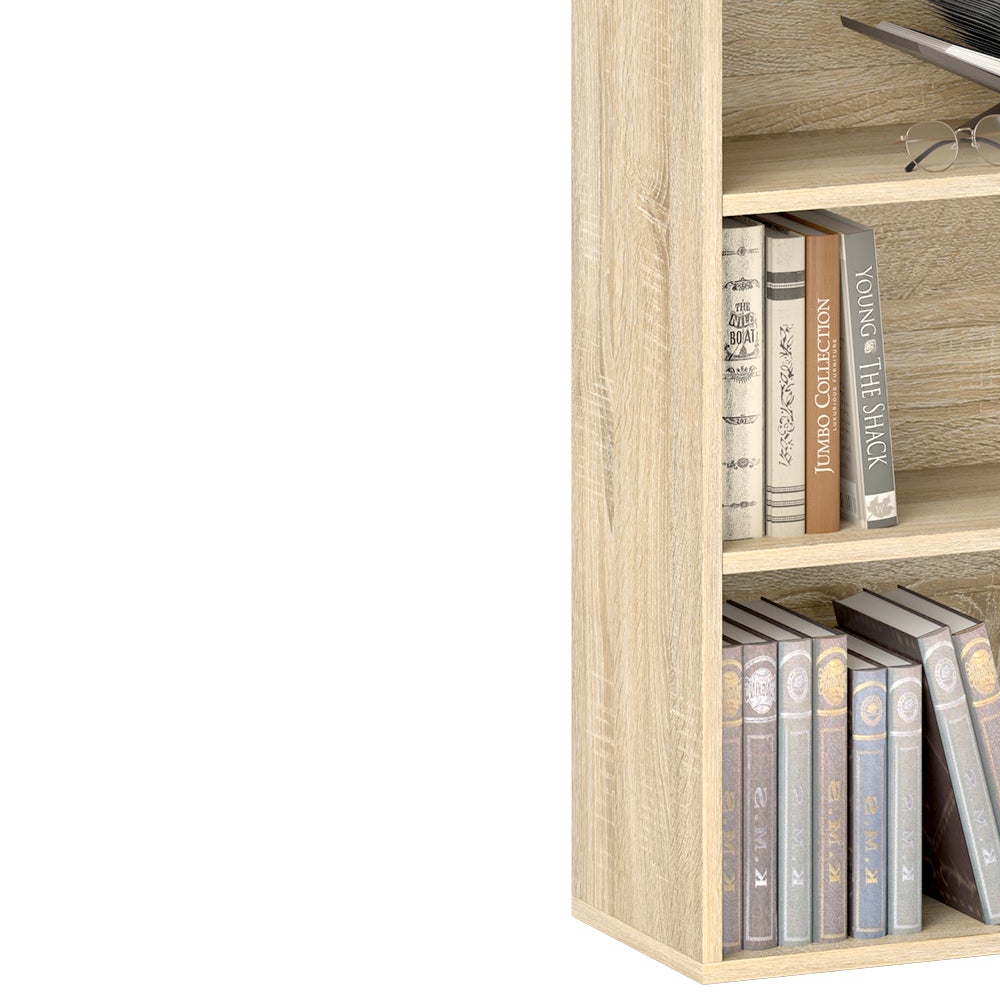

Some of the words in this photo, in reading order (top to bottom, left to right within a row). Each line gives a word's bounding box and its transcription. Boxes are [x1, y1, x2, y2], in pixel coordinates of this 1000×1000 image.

[735, 301, 751, 312] THE
[855, 265, 877, 337] YOUNG
[730, 329, 754, 345] BOAT
[814, 298, 831, 409] COLLECTION
[859, 356, 882, 398] THE
[814, 414, 835, 475] JUMBO
[862, 403, 887, 470] SHACK
